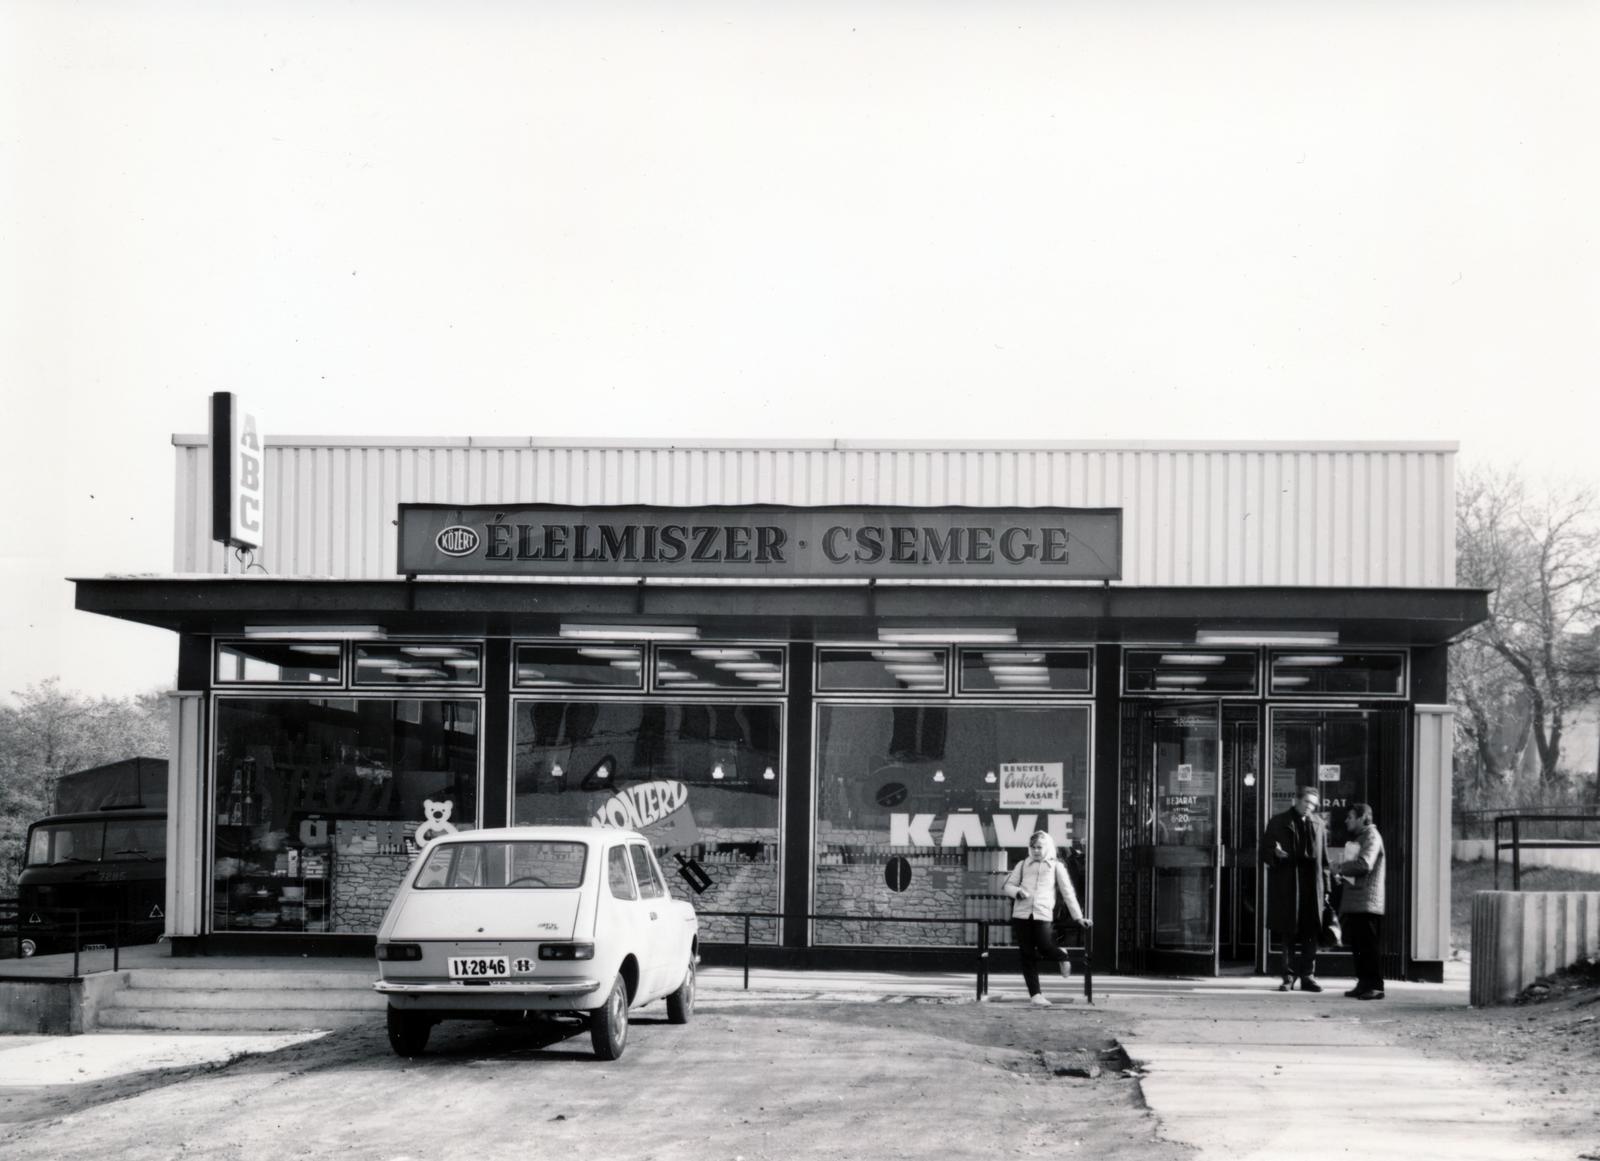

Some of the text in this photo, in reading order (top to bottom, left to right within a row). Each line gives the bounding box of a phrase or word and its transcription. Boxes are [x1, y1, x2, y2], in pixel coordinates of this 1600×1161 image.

[240, 413, 260, 532] ABC
[442, 529, 474, 551] KÖZÉRT
[486, 511, 1068, 563] ÉLELMISZER CSEMEGE
[516, 959, 530, 972] H
